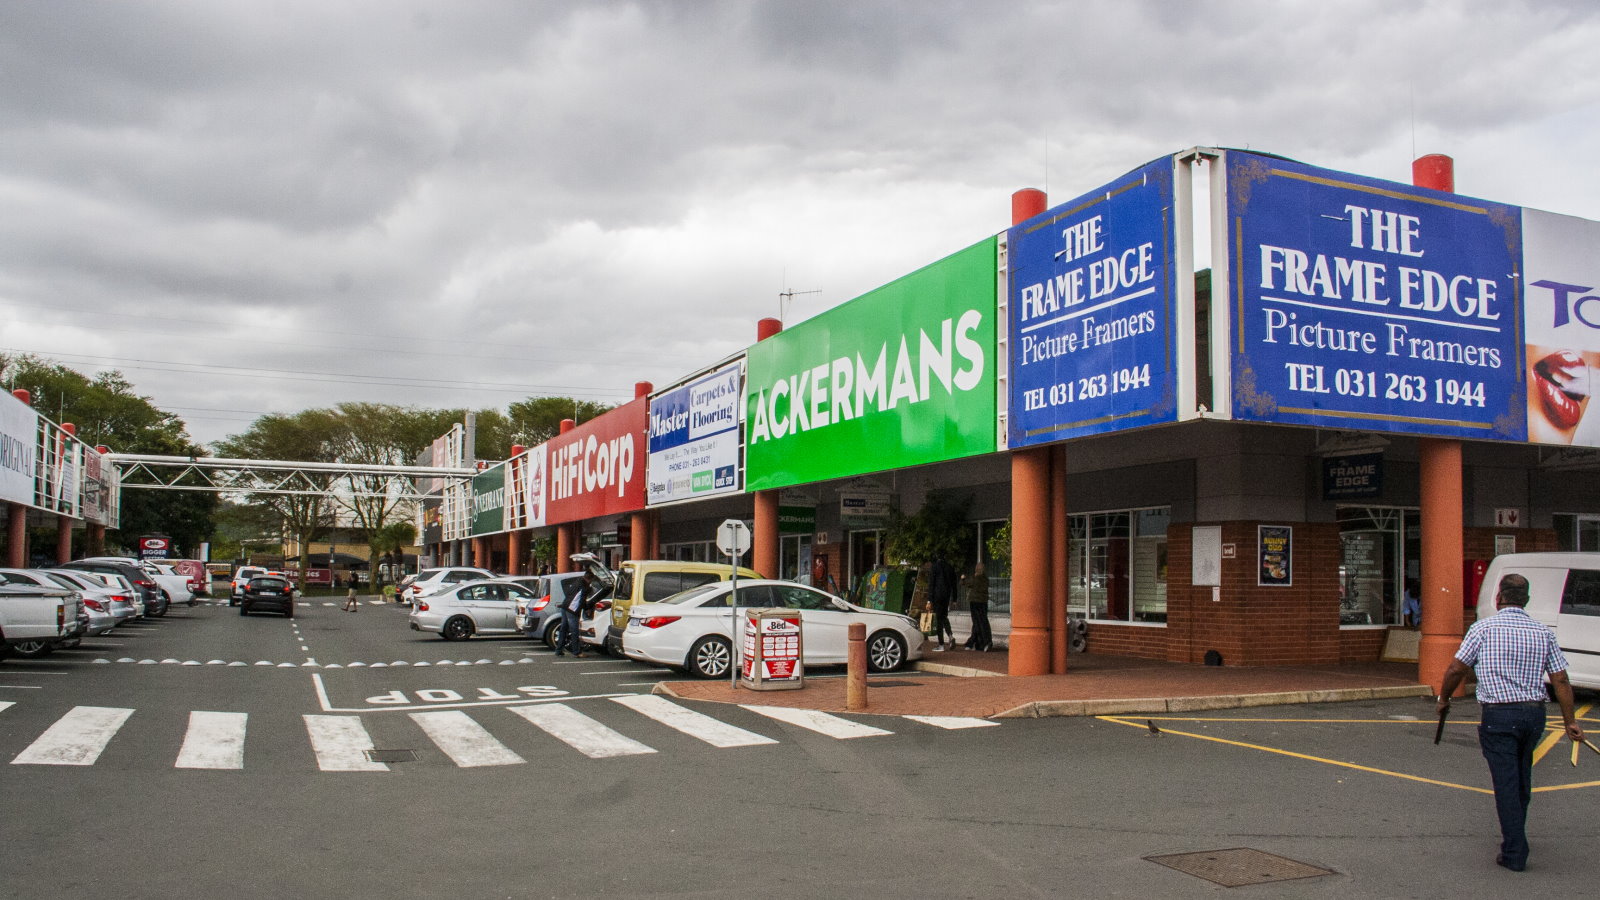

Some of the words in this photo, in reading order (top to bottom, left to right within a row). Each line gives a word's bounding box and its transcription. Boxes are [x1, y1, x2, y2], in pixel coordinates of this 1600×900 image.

[1062, 215, 1104, 263] THE
[1345, 204, 1424, 258] THE
[1021, 268, 1085, 322] FRAME
[1089, 242, 1155, 300] EDGE
[1260, 244, 1390, 306] FRAME
[1398, 265, 1500, 320] EDGE
[1021, 334, 1078, 366] Picture
[1081, 310, 1155, 349] Framers
[1262, 308, 1377, 354] Picture
[1385, 323, 1501, 369] Framers
[690, 384, 725, 407] Carpets
[727, 375, 736, 395] &
[751, 309, 985, 445] ACKERMANS
[1024, 387, 1047, 411] TEL
[1050, 381, 1073, 406] 031
[1078, 374, 1107, 400] 263
[1112, 363, 1151, 394] 1944
[1285, 362, 1330, 395] TEL
[1335, 368, 1377, 398] 031
[1385, 373, 1427, 403] 263
[1435, 378, 1486, 408] 1944
[650, 410, 689, 438] Master
[693, 402, 733, 429] Flooring
[552, 432, 635, 501] HiFiCorp
[1330, 465, 1376, 477] FRAME
[1336, 476, 1369, 487] EDGE
[479, 487, 504, 513] NEDBANK
[771, 621, 786, 630] Bed
[365, 685, 570, 704] STOP
